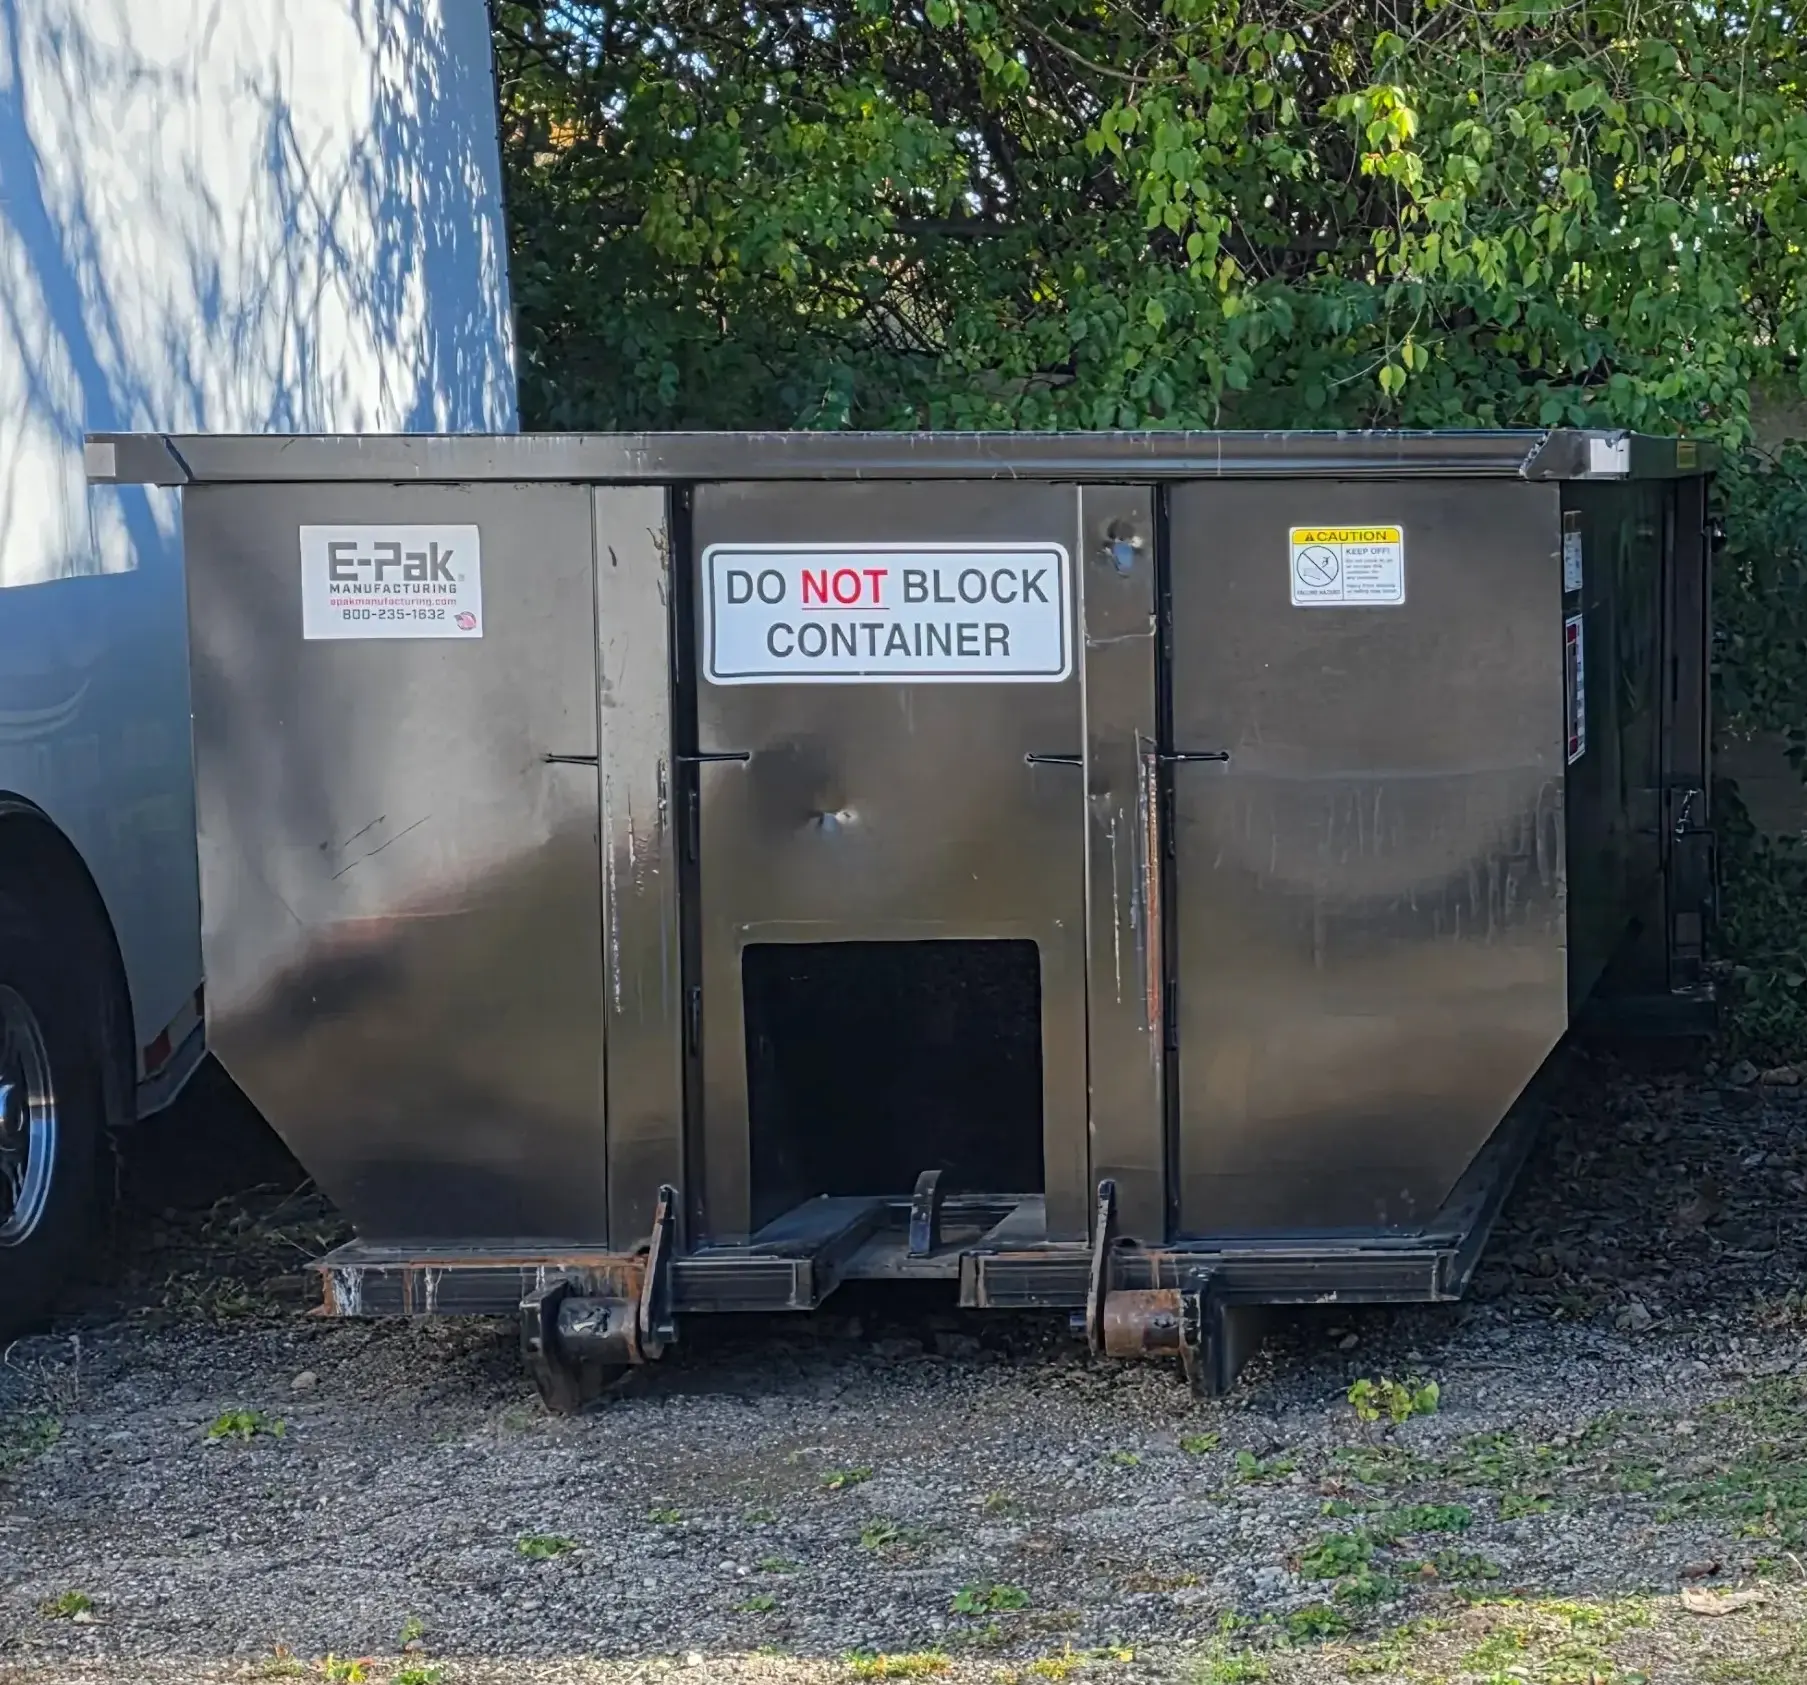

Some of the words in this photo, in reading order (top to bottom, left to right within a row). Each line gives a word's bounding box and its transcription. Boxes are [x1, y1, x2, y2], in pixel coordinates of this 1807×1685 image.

[1316, 531, 1387, 542] CAUTION
[1346, 547, 1368, 555] KEEP
[329, 583, 457, 594] MANUFACTURING
[726, 569, 787, 605] DO
[801, 568, 889, 605] NOT
[903, 568, 1049, 604] BLOCK
[330, 597, 457, 607] epakmanufacturing.com
[343, 609, 445, 620] 800-235-1632
[766, 622, 1011, 658] CONTAINER
